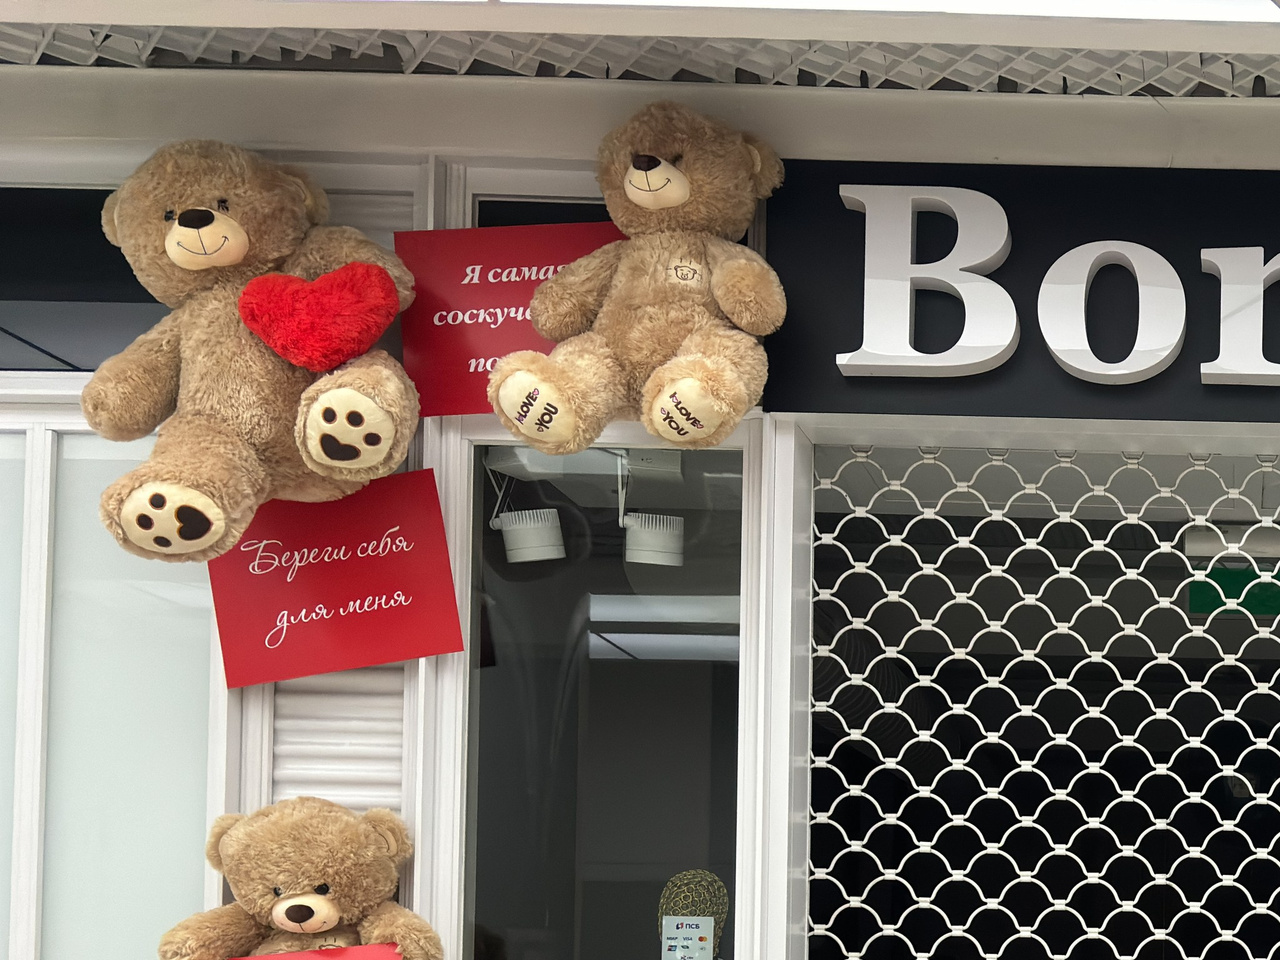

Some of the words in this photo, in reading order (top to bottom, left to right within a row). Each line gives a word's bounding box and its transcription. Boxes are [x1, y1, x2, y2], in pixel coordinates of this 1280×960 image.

[461, 265, 483, 285] Я
[520, 391, 538, 419] LOVE
[535, 402, 559, 430] YOU
[674, 400, 700, 429] LOVE
[663, 410, 689, 437] YOU
[240, 539, 353, 583] Береги
[356, 525, 415, 557] себя
[264, 604, 335, 649] для
[339, 590, 413, 616] меня
